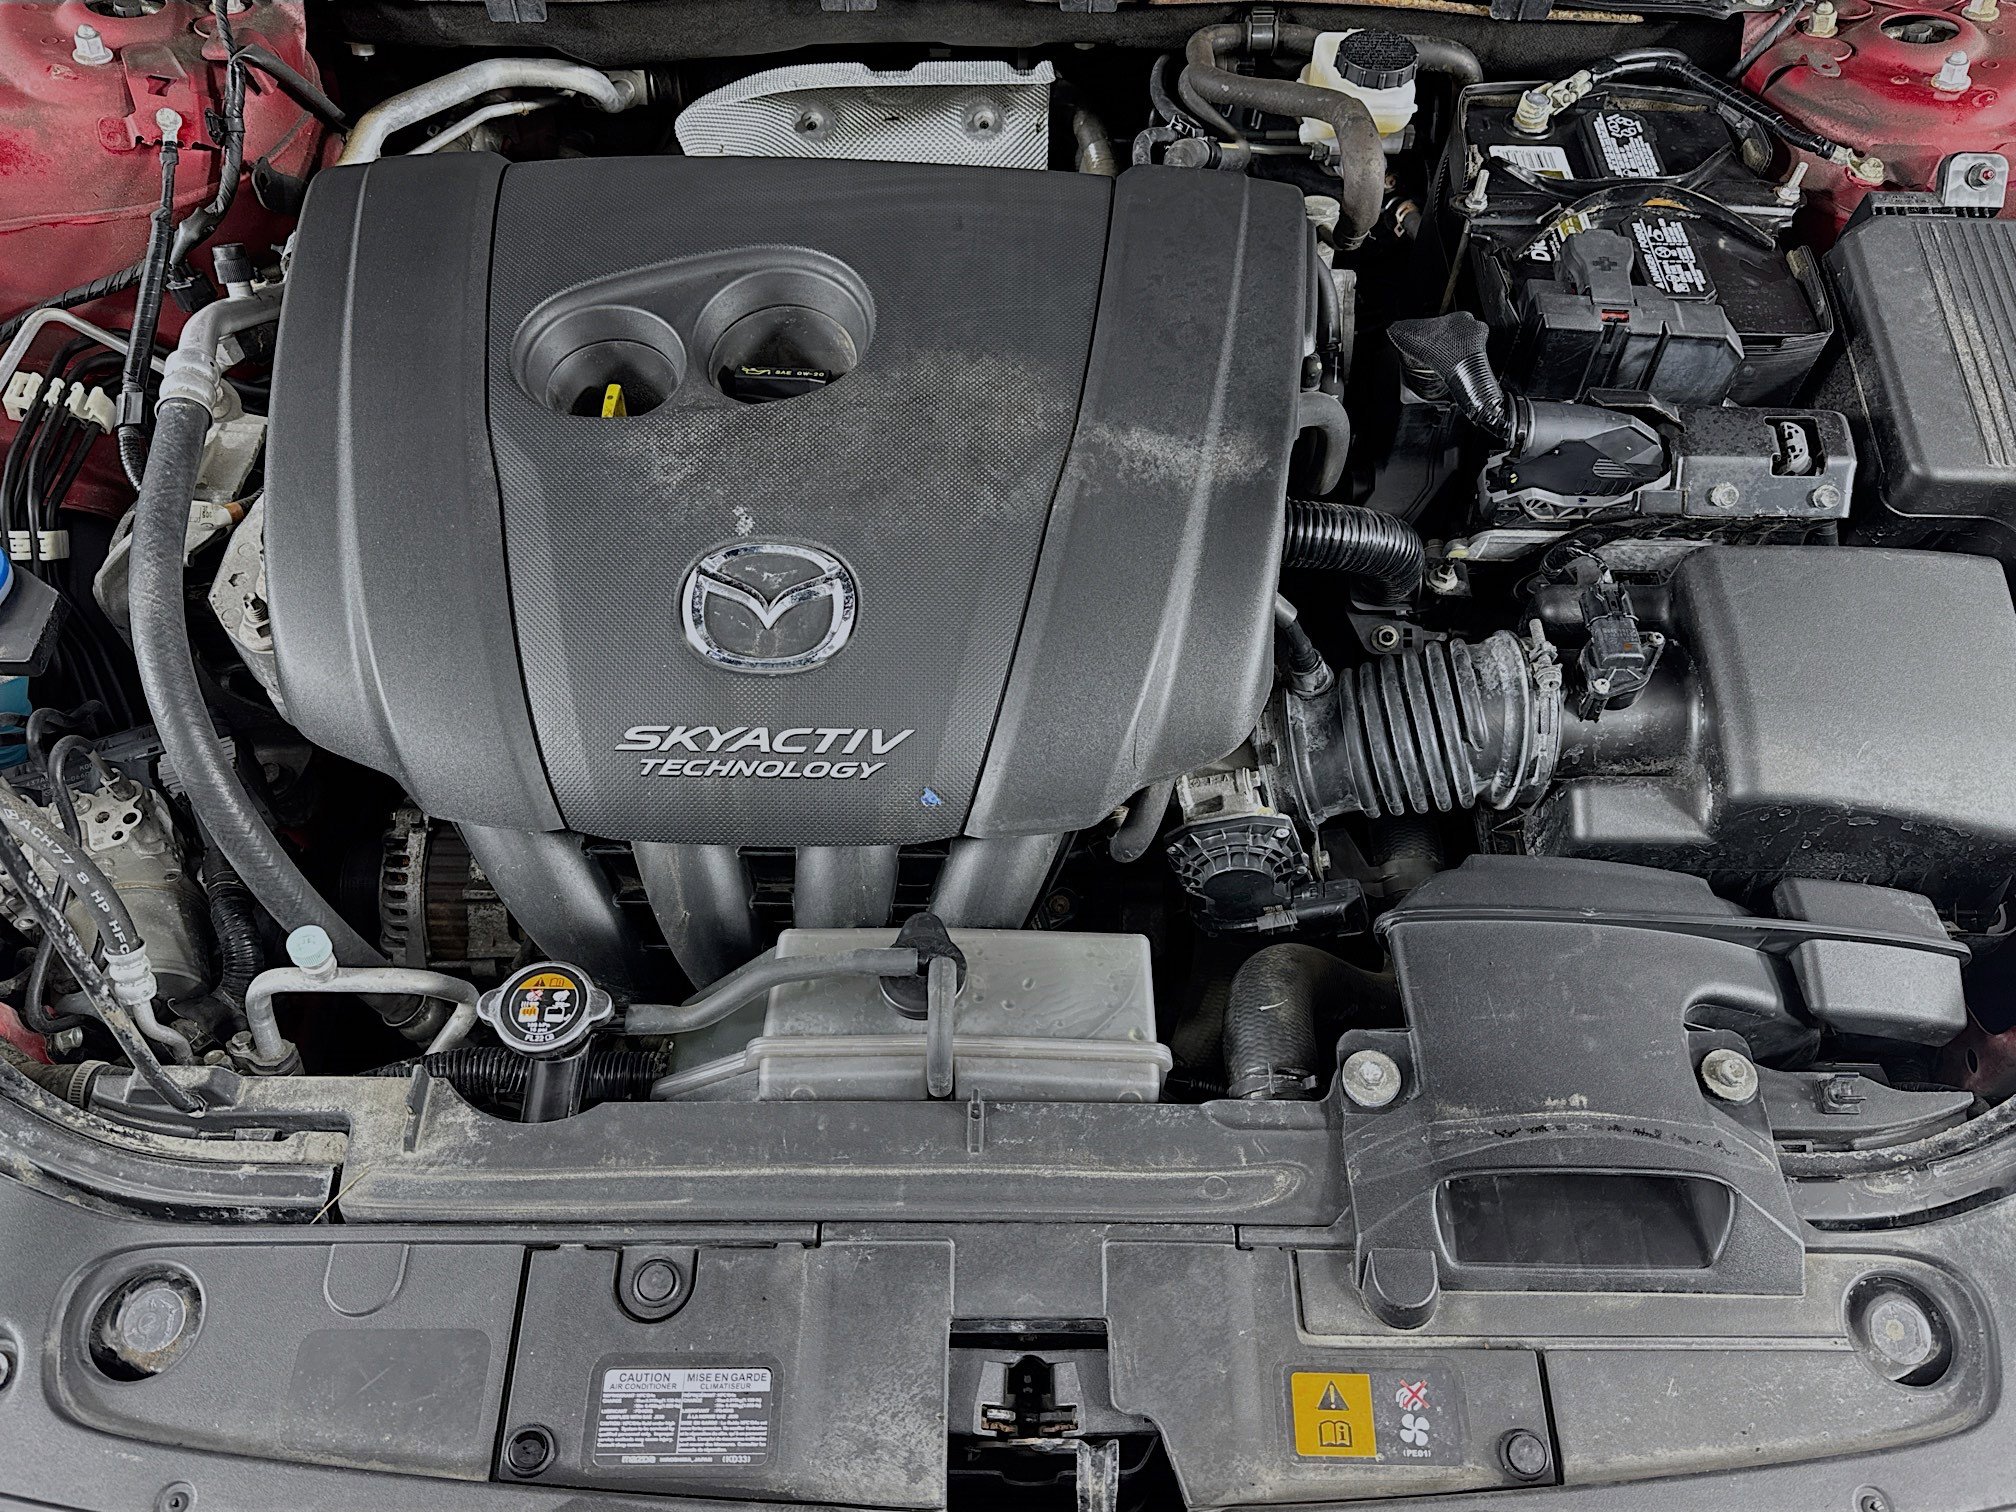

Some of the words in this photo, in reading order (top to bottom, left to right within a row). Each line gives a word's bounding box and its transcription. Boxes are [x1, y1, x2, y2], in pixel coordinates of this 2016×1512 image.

[614, 725, 916, 755] SKYACTIV
[640, 758, 887, 780] TECHNOLOGY
[76, 871, 91, 885] 8
[90, 890, 111, 914] HP
[619, 1372, 671, 1382] CAUTION
[687, 1372, 712, 1382] MISE
[714, 1372, 729, 1382] EN
[730, 1372, 768, 1382] GARDE
[700, 1382, 752, 1390] CLIMATISEUR
[1403, 1449, 1431, 1457] (PE01)
